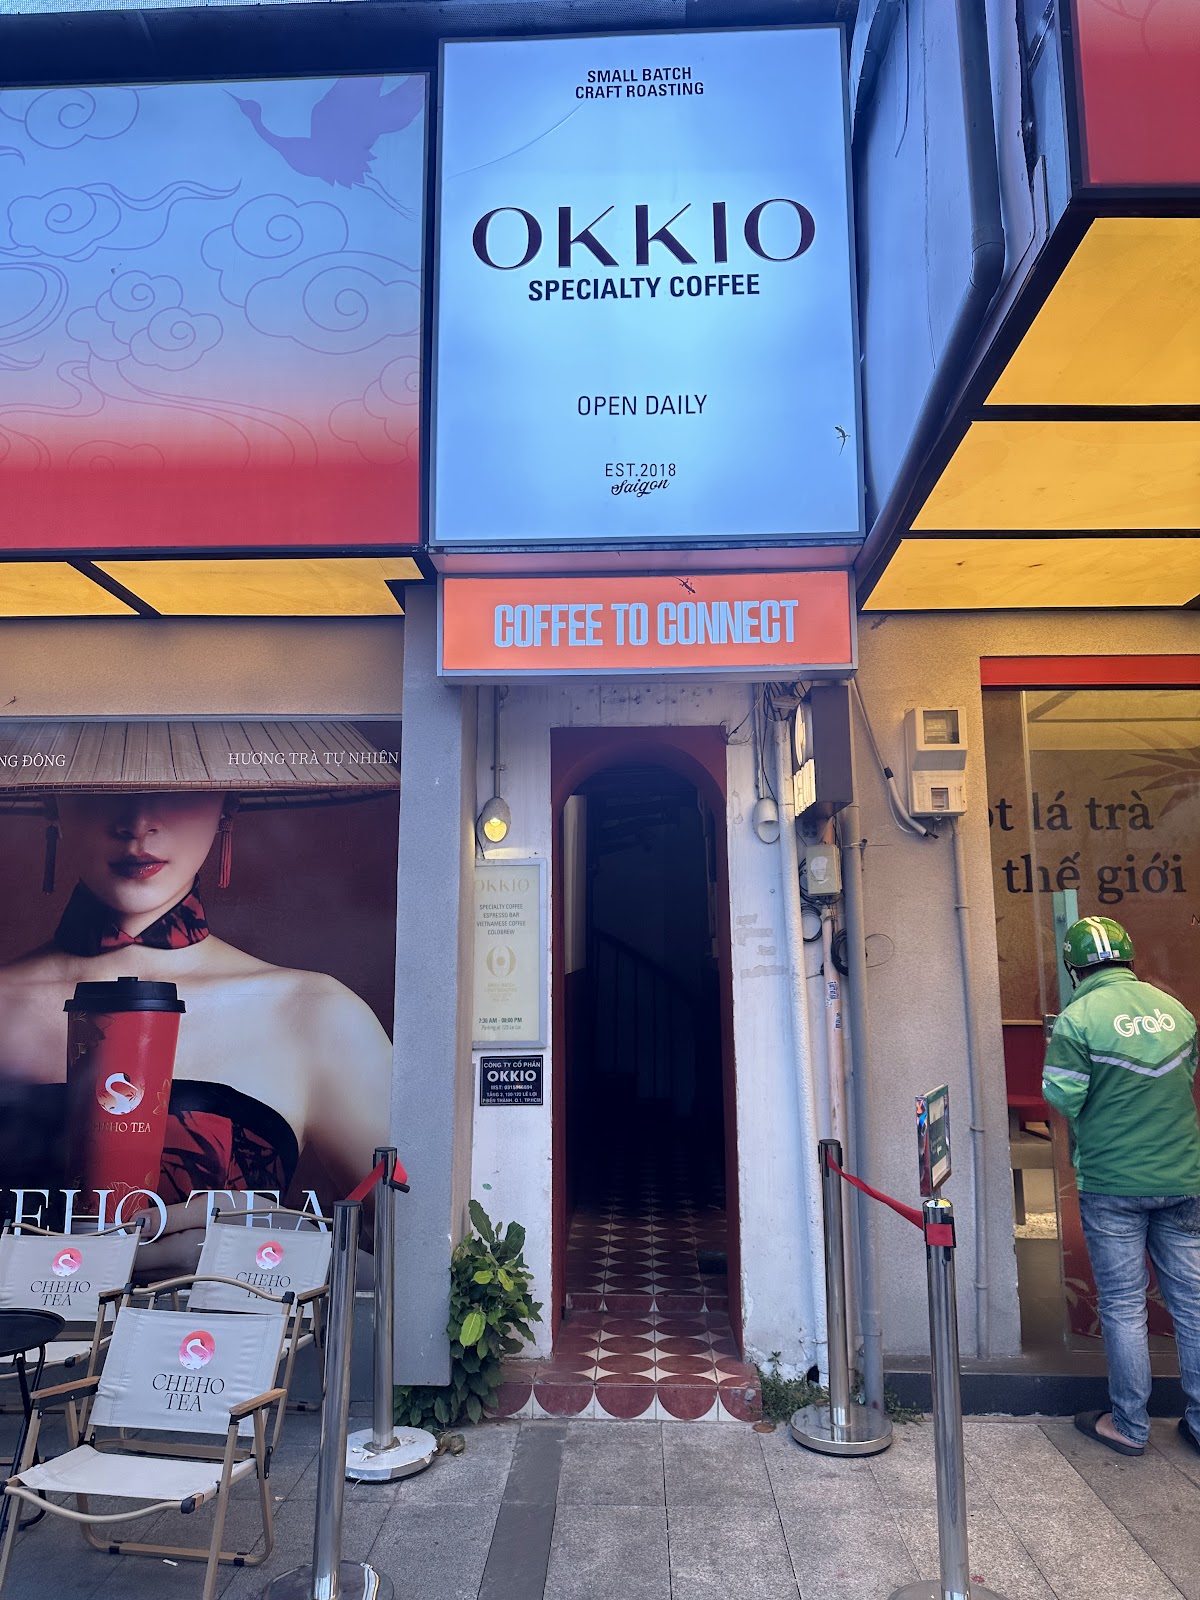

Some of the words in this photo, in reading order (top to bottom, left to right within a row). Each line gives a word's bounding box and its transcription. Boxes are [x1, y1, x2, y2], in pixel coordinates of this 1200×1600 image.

[587, 69, 638, 83] SMALL
[642, 66, 692, 81] BATCH
[575, 85, 623, 99] CRAFT
[626, 82, 705, 98] ROASTING
[472, 198, 816, 271] OKKIO
[528, 277, 661, 301] SPECIALTY
[669, 273, 760, 297] COFFEE
[577, 395, 637, 416] OPEN
[646, 394, 708, 415] DAILY
[605, 462, 676, 477] EST.2018
[611, 478, 671, 498] Saigon
[494, 603, 603, 648] COFFEE
[611, 602, 649, 646] TO
[657, 600, 799, 646] CONNECT
[22, 752, 66, 767] ĐÔNG
[228, 750, 285, 765] HƯƠNG
[289, 749, 320, 765] TRÀ
[323, 750, 346, 767] TỰ
[348, 749, 399, 764] NHIÊN
[1032, 789, 1073, 831] lá
[1085, 789, 1155, 831] trà
[1002, 851, 1081, 894] thế
[1097, 851, 1187, 905] giới
[1113, 1008, 1176, 1037] Grab
[487, 1069, 537, 1082] OKKIO
[130, 1122, 151, 1133] TEA
[185, 1190, 328, 1246] TEA
[30, 1280, 91, 1293] CHEHO
[235, 1271, 291, 1288] CHEHO
[41, 1293, 72, 1306] TEA
[152, 1373, 225, 1395] CHEHO
[165, 1392, 203, 1412] TEA
